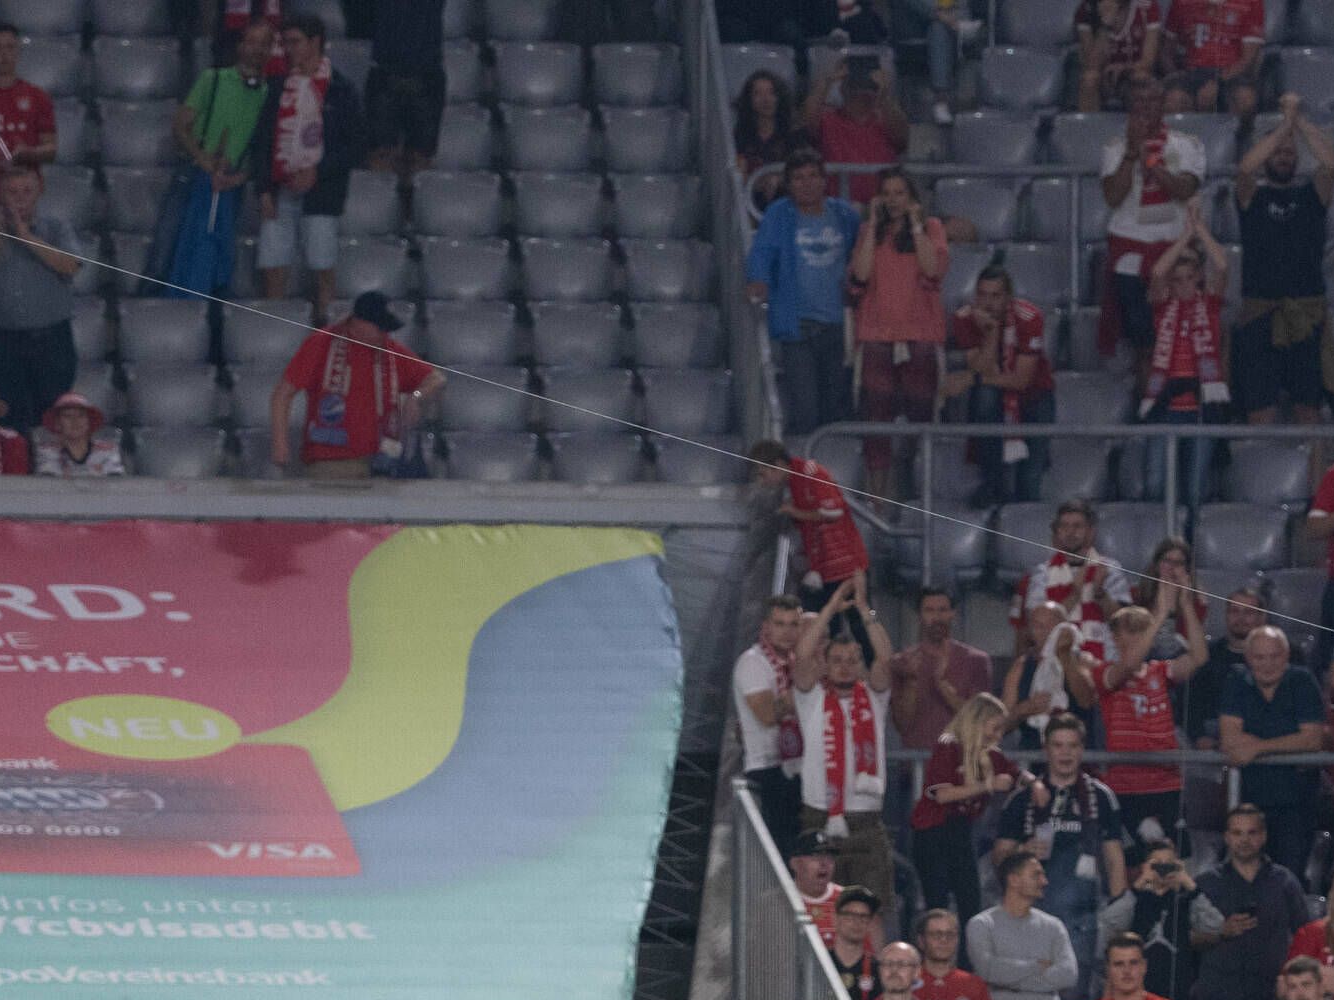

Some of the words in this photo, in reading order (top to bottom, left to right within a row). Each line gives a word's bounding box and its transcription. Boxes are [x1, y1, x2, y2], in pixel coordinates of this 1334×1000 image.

[67, 716, 221, 741] NEU
[206, 843, 336, 859] VISA
[0, 894, 127, 915] Infos
